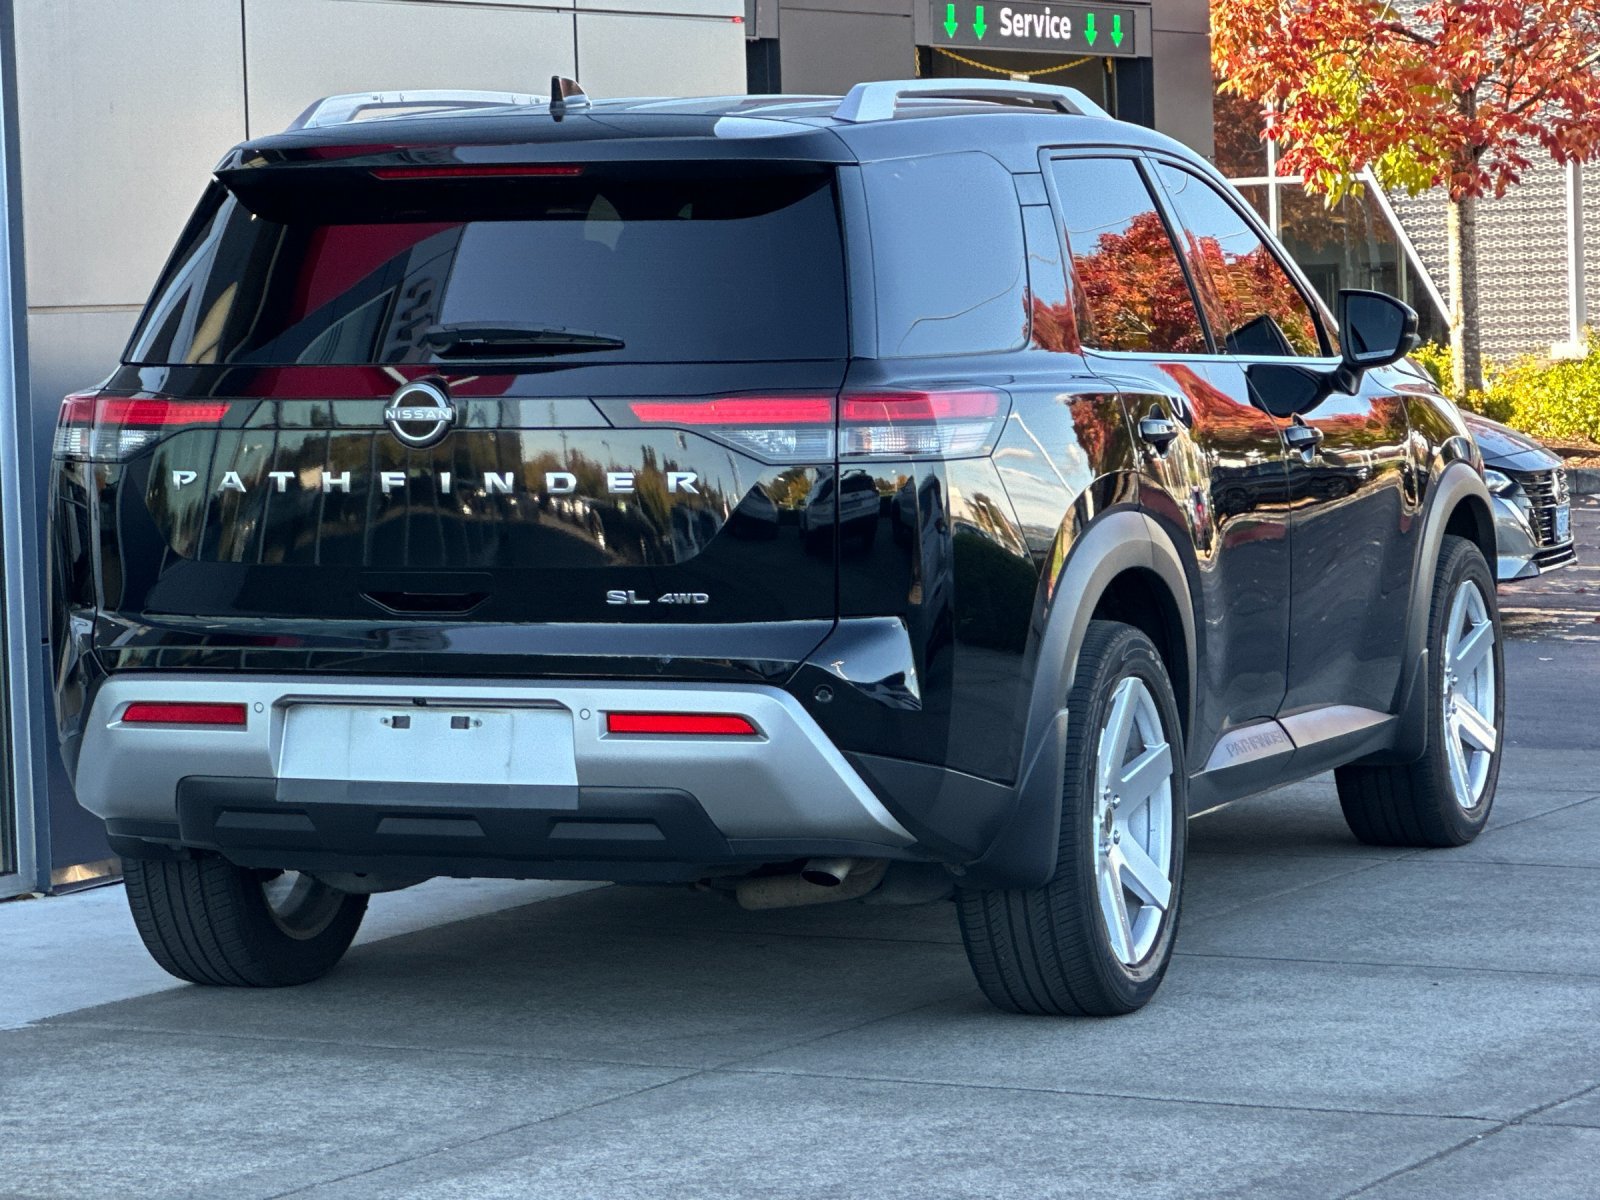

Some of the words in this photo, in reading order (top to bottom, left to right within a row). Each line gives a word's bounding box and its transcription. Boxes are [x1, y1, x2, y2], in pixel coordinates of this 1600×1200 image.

[1000, 7, 1071, 40] Service
[385, 409, 451, 419] NISSAN
[172, 470, 699, 494] PATHFINDER
[606, 590, 650, 604] SL
[657, 593, 709, 604] 4WD
